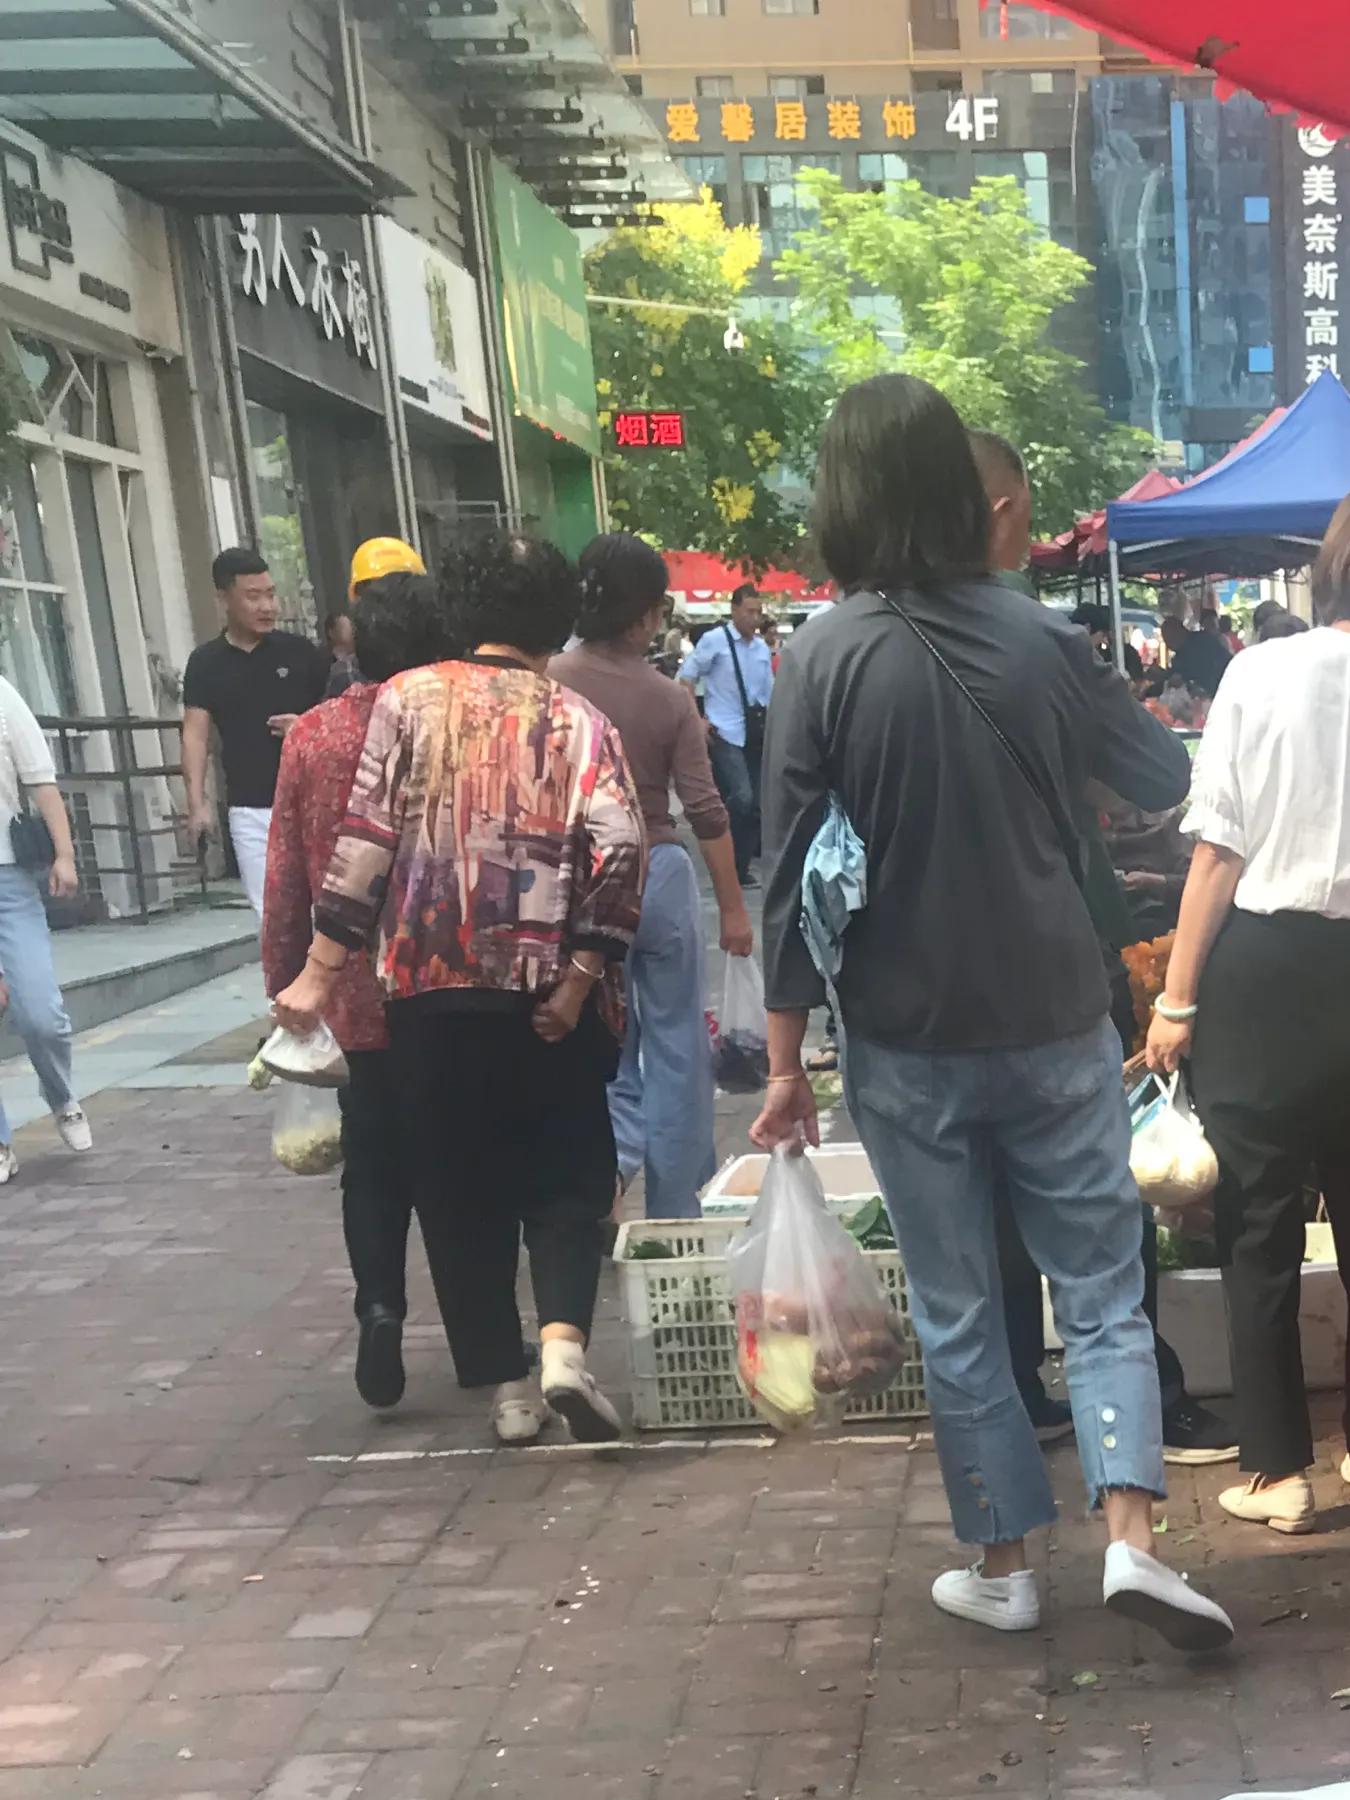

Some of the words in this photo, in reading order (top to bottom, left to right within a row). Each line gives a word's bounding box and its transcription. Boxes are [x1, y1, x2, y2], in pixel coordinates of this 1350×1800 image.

[666, 101, 917, 142] 爱馨居装饰
[945, 98, 999, 141] 4F
[616, 413, 684, 445] 烟酒
